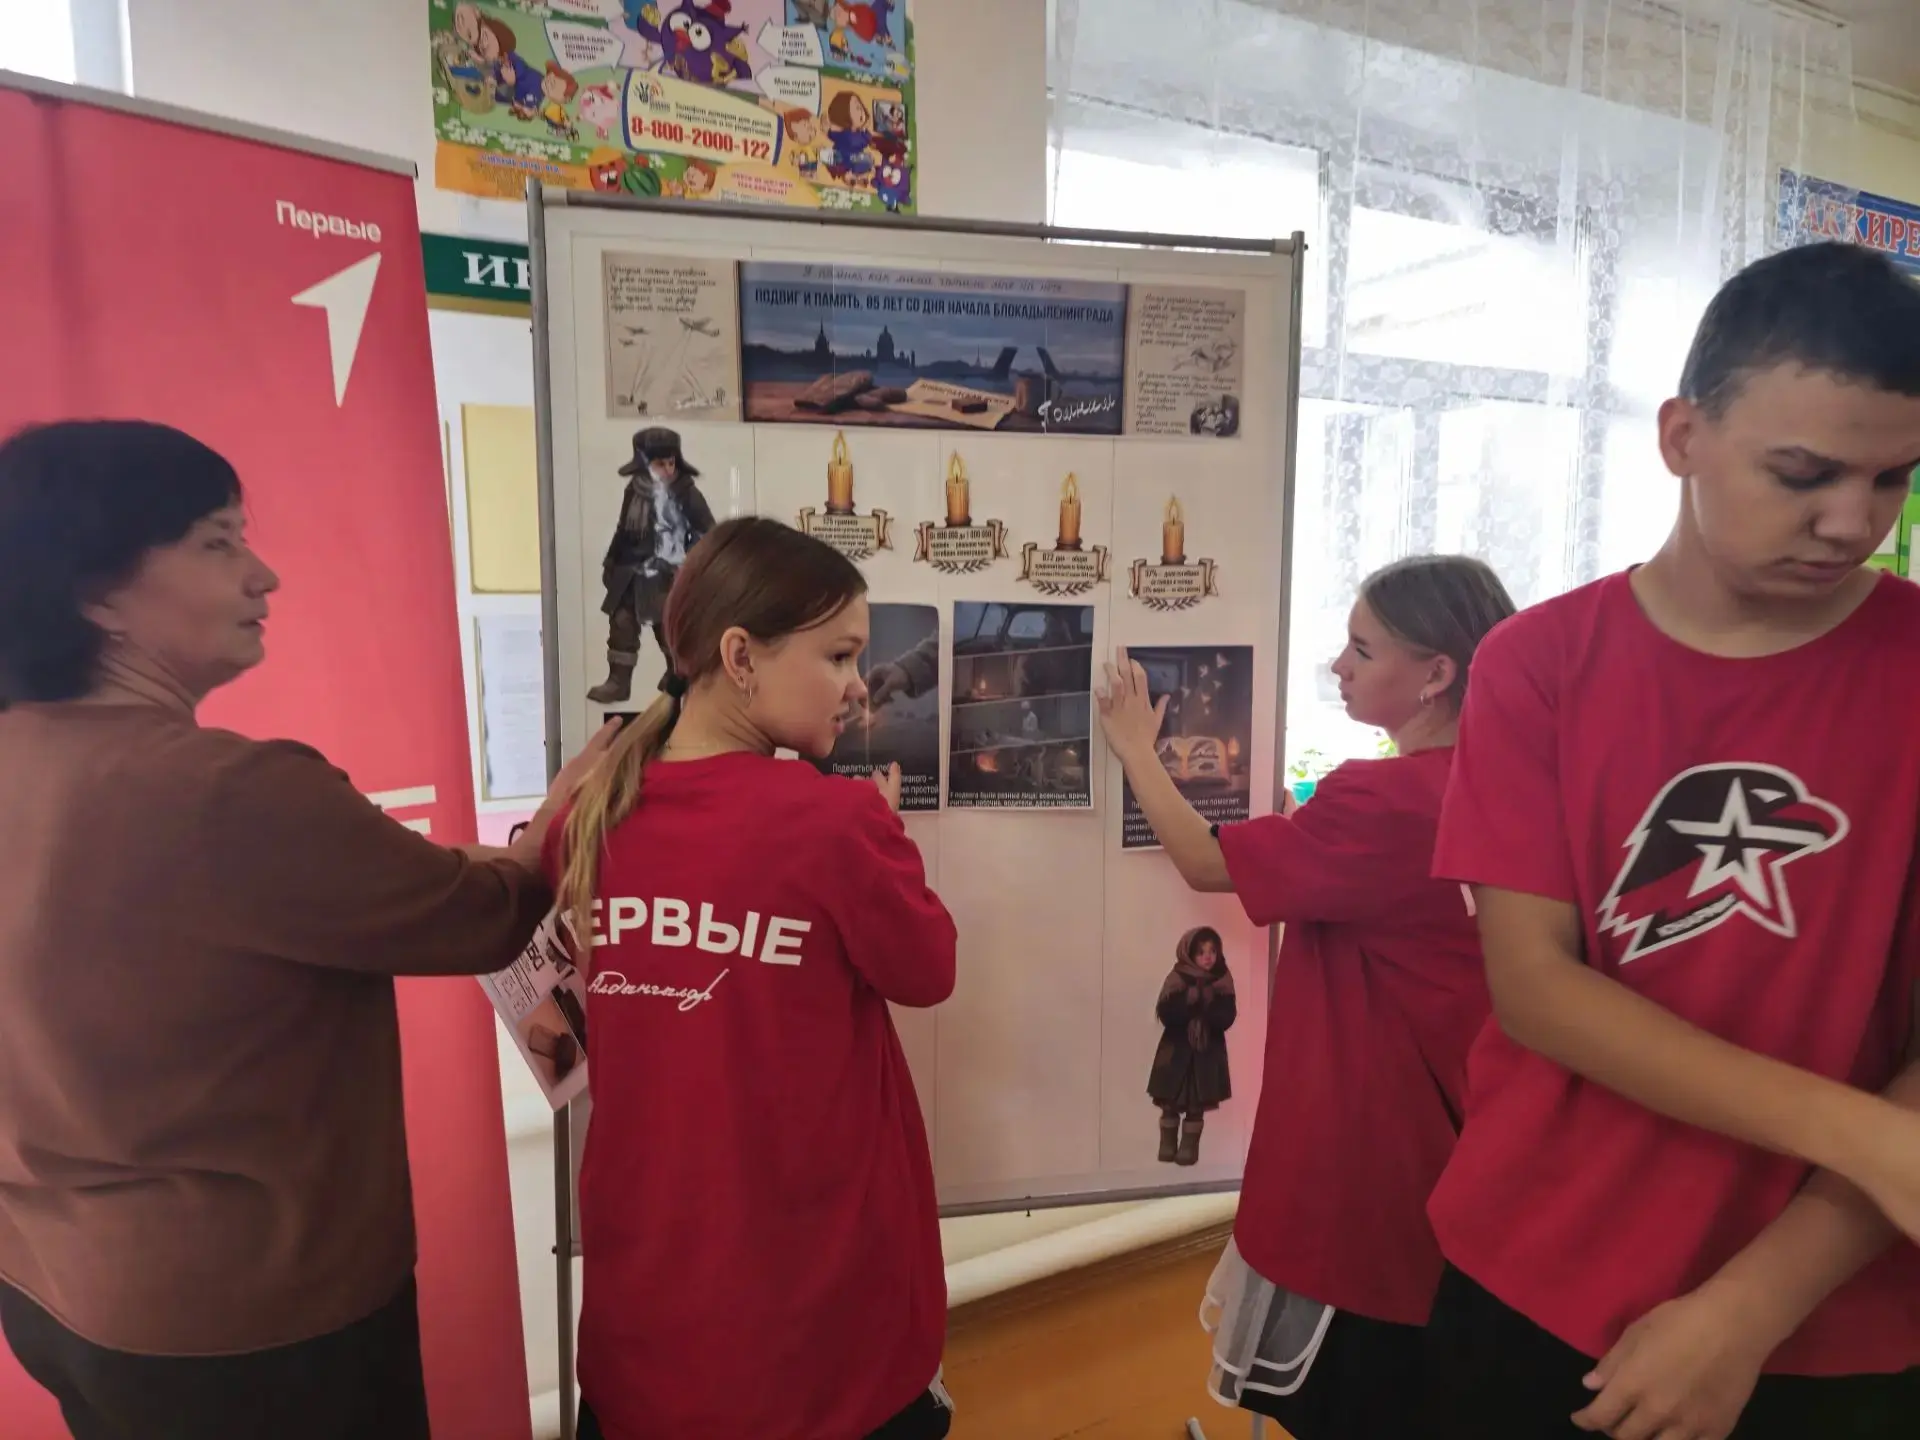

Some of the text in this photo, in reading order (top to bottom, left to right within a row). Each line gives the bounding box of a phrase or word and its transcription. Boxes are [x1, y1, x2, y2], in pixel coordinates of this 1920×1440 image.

[631, 115, 771, 160] 8-800-2000-122
[276, 199, 382, 243] Первые
[755, 287, 800, 306] ПОДВИГ
[803, 291, 811, 307] И
[883, 295, 902, 312] ЛЕТ
[905, 297, 920, 312] СО
[922, 298, 945, 315] ДНЯ
[949, 300, 991, 317] НАЧАЛА
[832, 762, 874, 775] Поделиться
[910, 783, 939, 797] простой
[590, 896, 813, 967] ЕРВЫЕ
